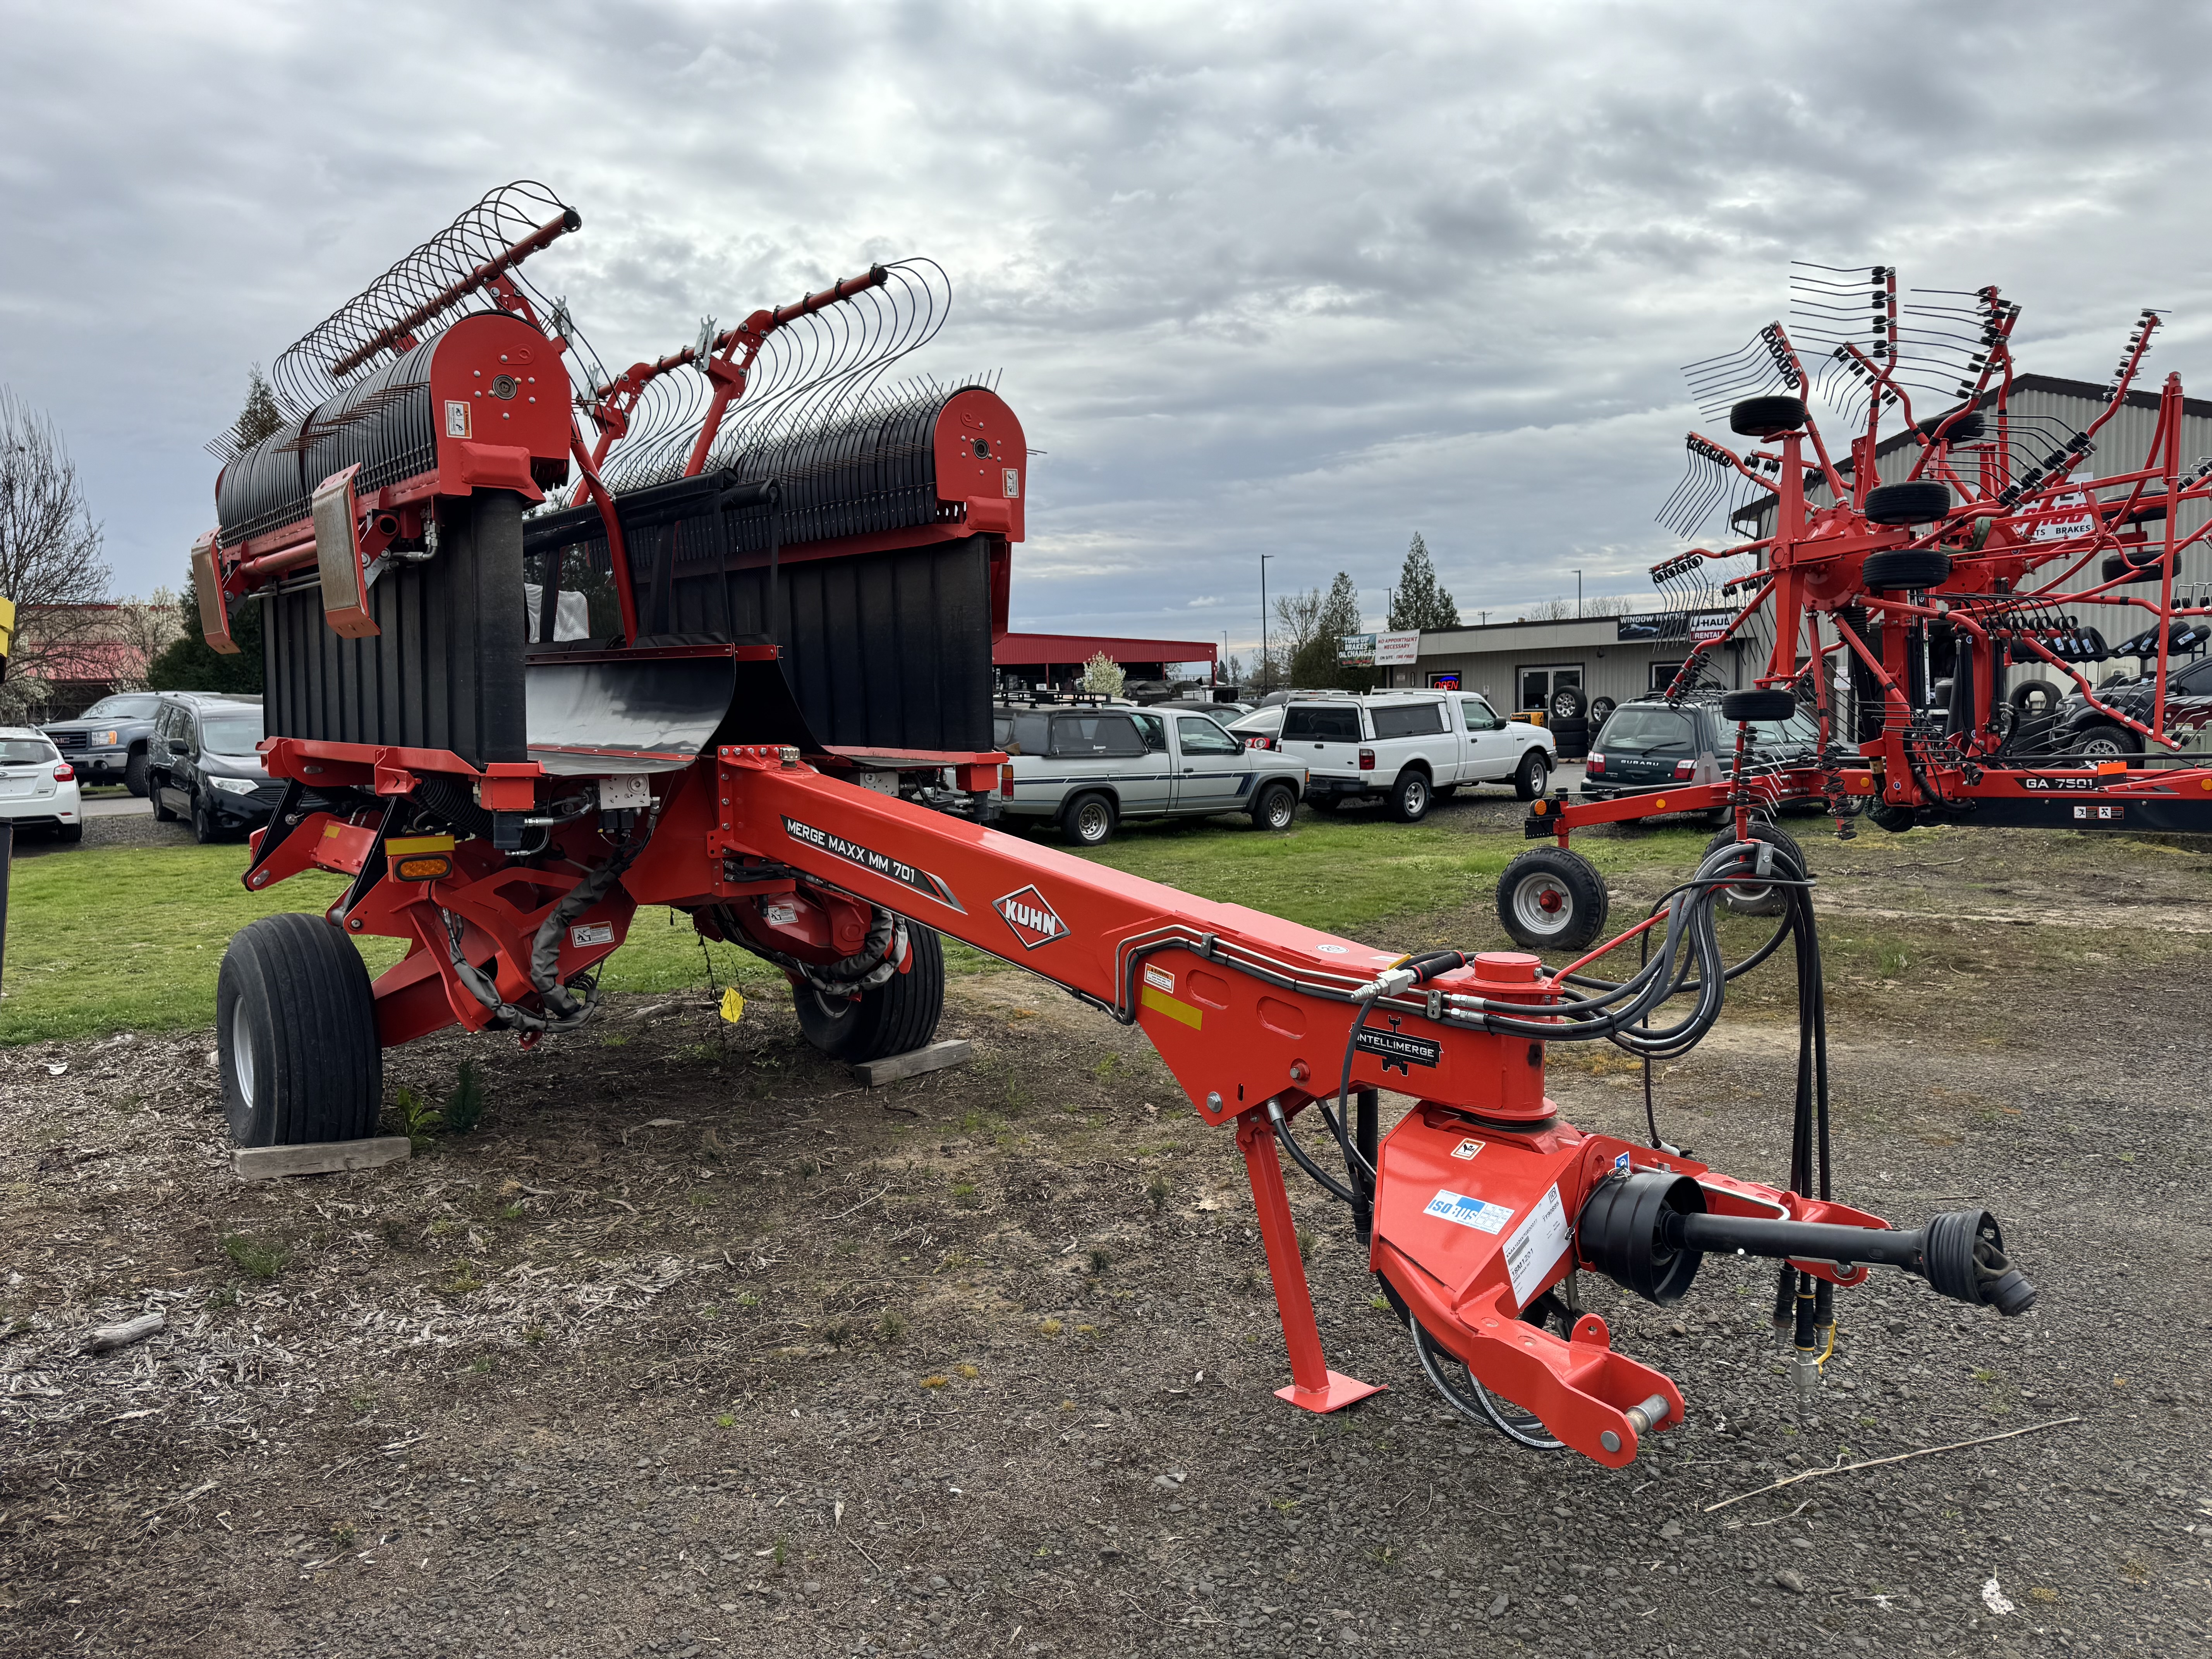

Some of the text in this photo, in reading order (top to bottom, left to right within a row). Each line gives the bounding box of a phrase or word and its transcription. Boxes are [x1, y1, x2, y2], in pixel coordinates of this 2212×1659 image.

[2056, 525, 2091, 534] BRAKES
[1620, 615, 1654, 624] WINDOW
[1692, 618, 1730, 627] U-HAUL
[1695, 631, 1725, 639] RENTAL
[1345, 643, 1368, 651] BRAKES
[1347, 649, 1376, 658] CHANGES
[1434, 680, 1459, 690] OPEN
[2026, 779, 2093, 788] GA 7501
[787, 819, 915, 883] MERGE MAXX MM 701
[1005, 898, 1056, 937] KUHN
[1357, 1033, 1434, 1058] INTELLIMERGE
[1550, 1190, 1556, 1199] ID
[1428, 1199, 1479, 1221] ISOBUS
